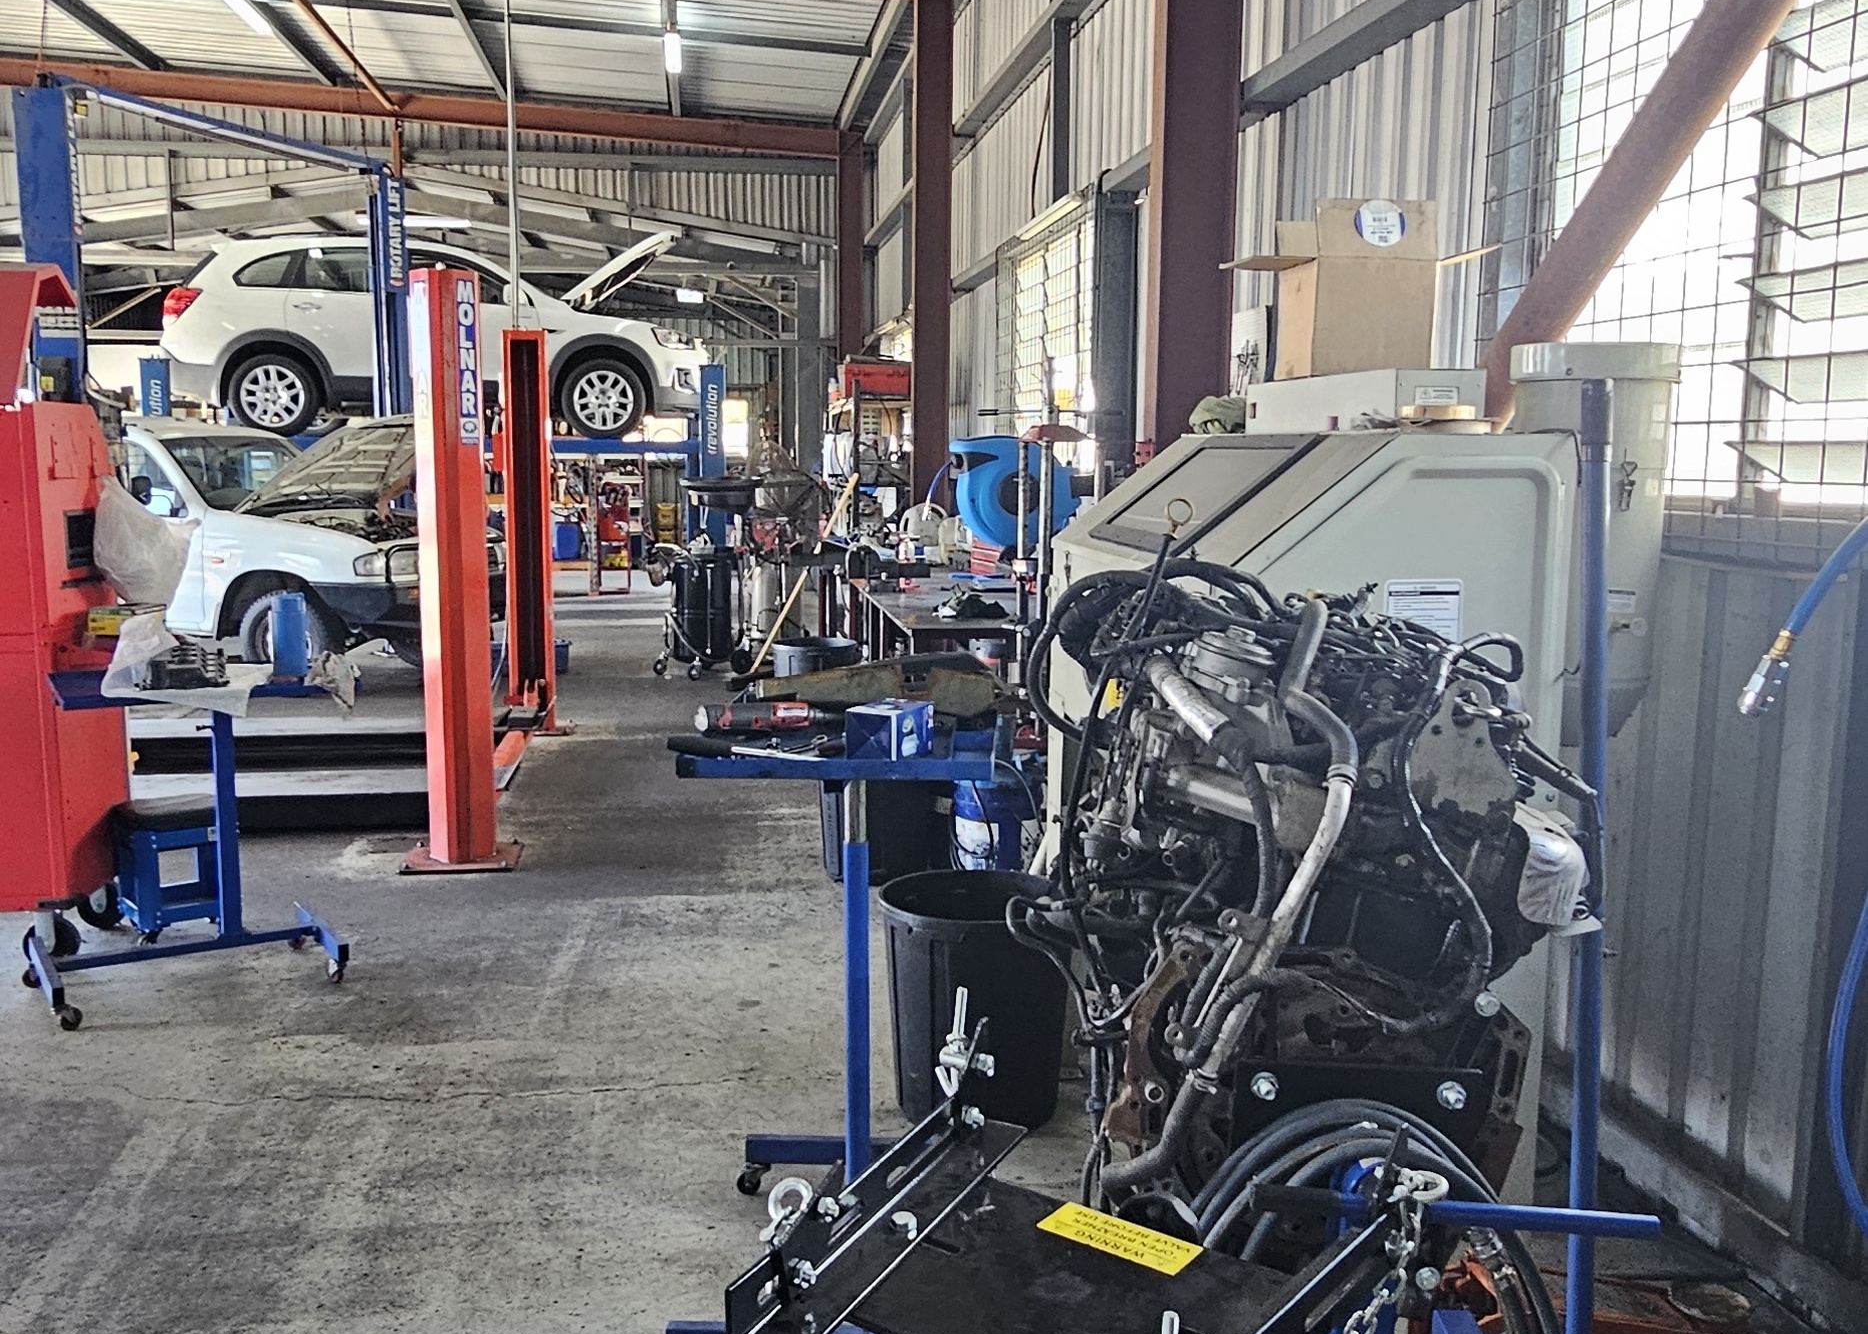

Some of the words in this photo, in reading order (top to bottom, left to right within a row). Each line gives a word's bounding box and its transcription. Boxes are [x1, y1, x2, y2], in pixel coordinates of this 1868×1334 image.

[386, 177, 401, 213] LIFT
[388, 214, 403, 278] ROTARY
[457, 280, 477, 416] MOLNAR
[706, 383, 719, 450] revolution
[1072, 1218, 1137, 1244] BREATHER
[1103, 1220, 1150, 1239] BEFORE
[1074, 1230, 1145, 1259] WARNING
[1139, 1241, 1174, 1256] OPEN
[1154, 1238, 1191, 1253] VALVE
